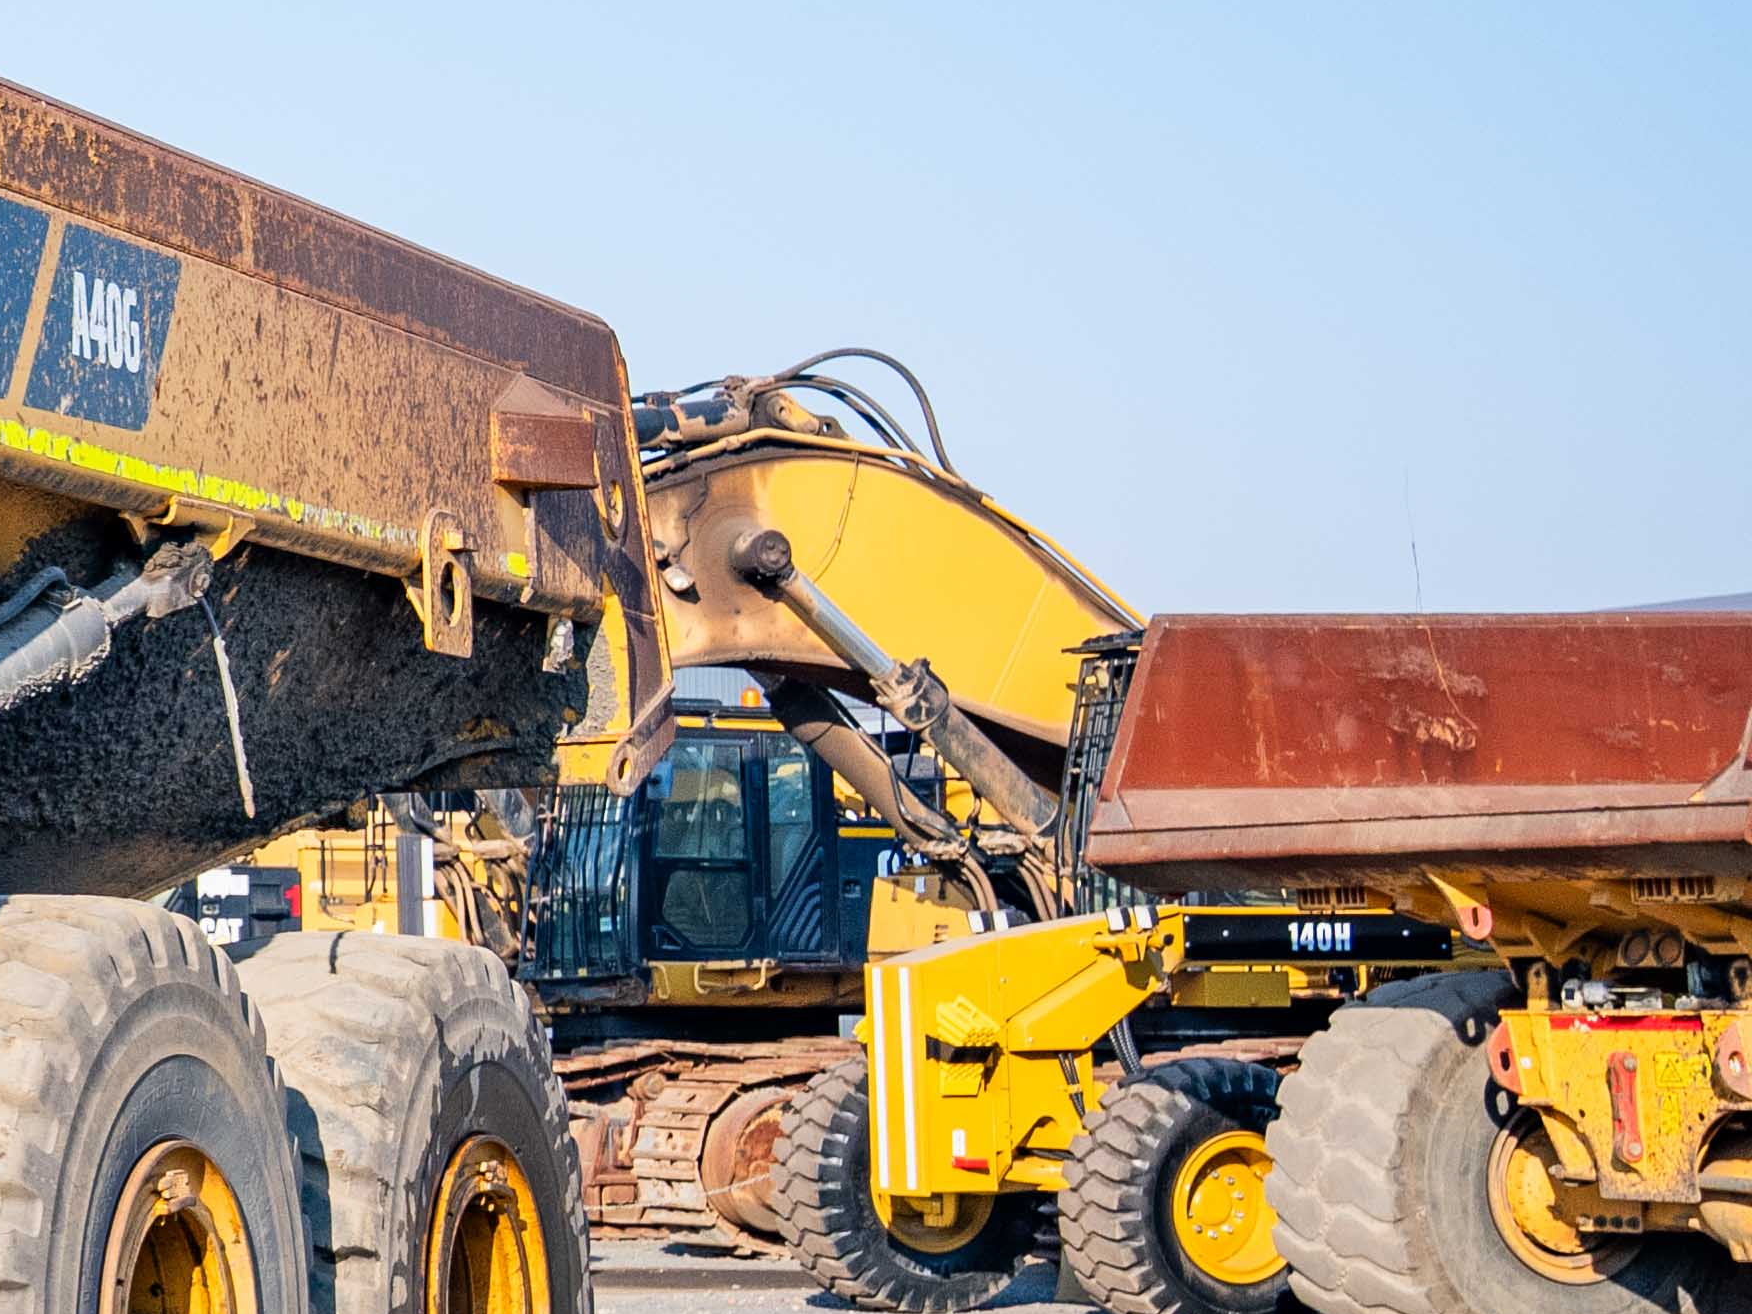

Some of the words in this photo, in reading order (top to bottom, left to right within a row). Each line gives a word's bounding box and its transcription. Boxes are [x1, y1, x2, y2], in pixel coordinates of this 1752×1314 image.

[72, 271, 141, 373] A40G
[200, 917, 243, 945] CAT
[1288, 923, 1351, 952] 140H
